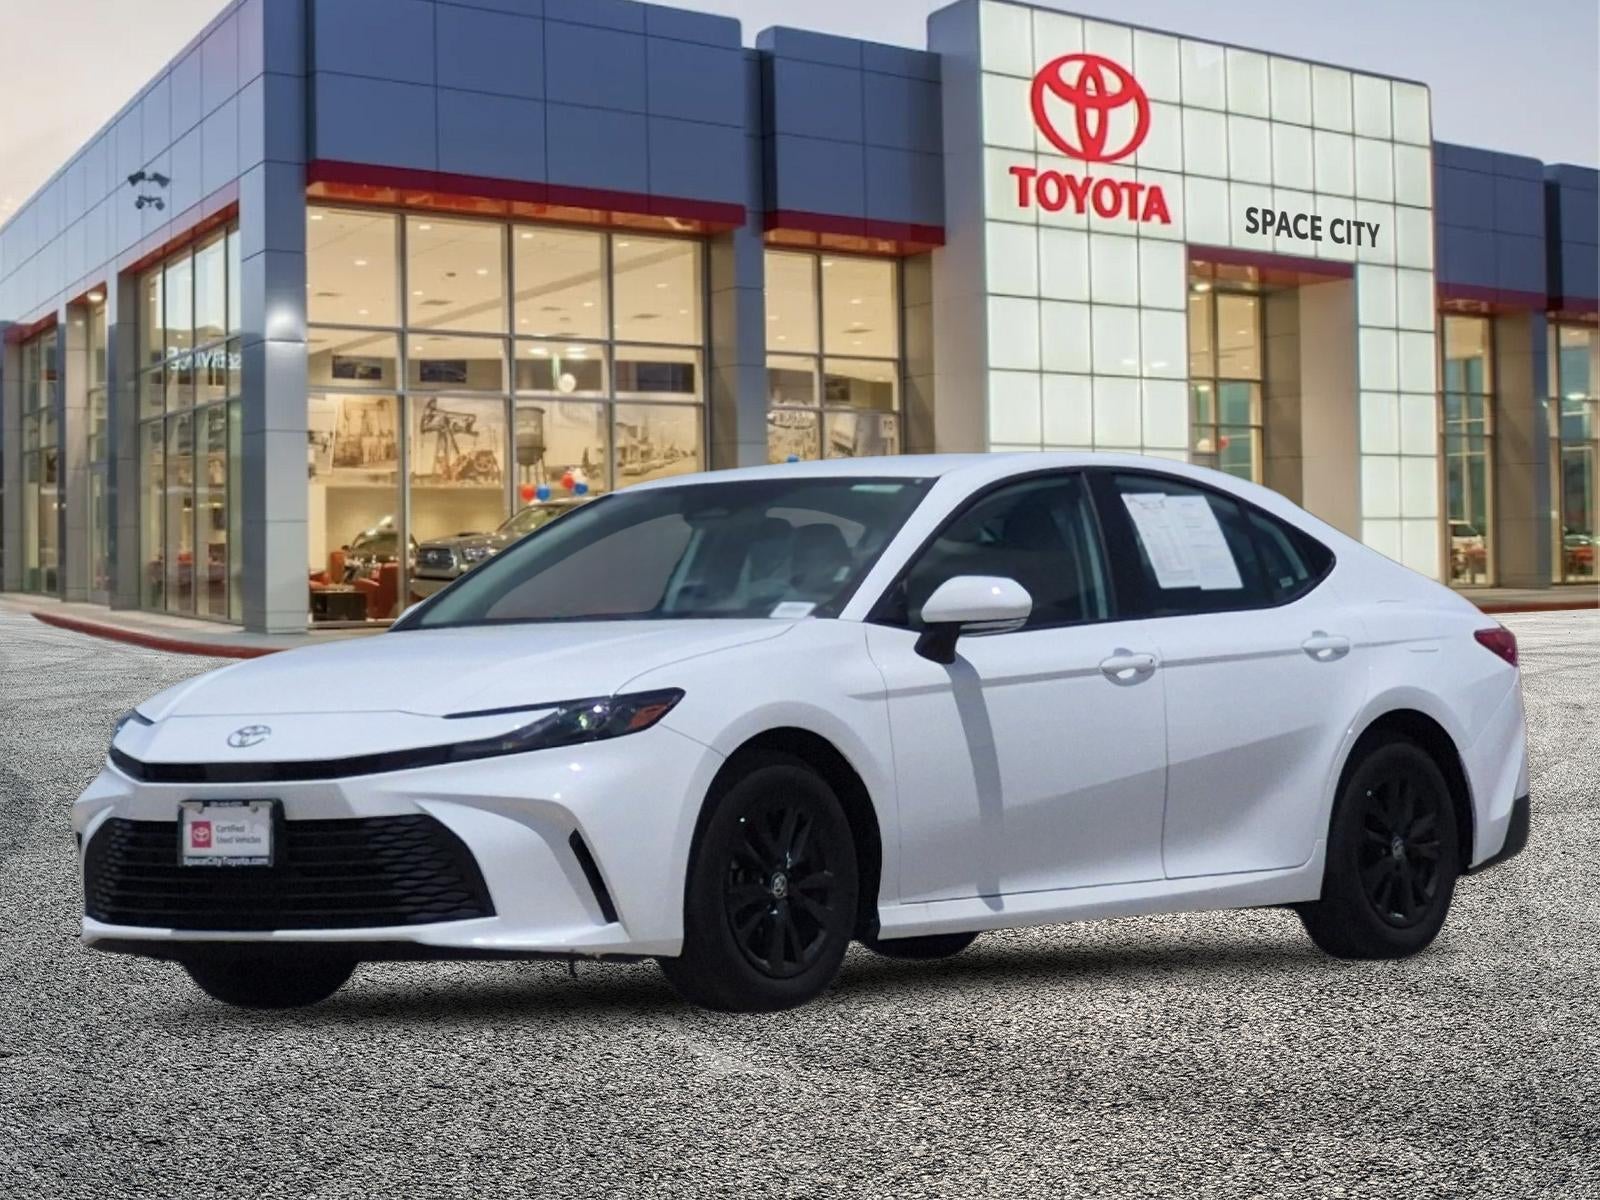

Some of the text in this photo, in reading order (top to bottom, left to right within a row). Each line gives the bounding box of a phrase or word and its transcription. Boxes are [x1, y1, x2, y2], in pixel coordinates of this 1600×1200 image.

[1009, 166, 1171, 225] TOYOTA
[1245, 206, 1381, 248] SPACE CITY
[216, 824, 245, 833] Certified
